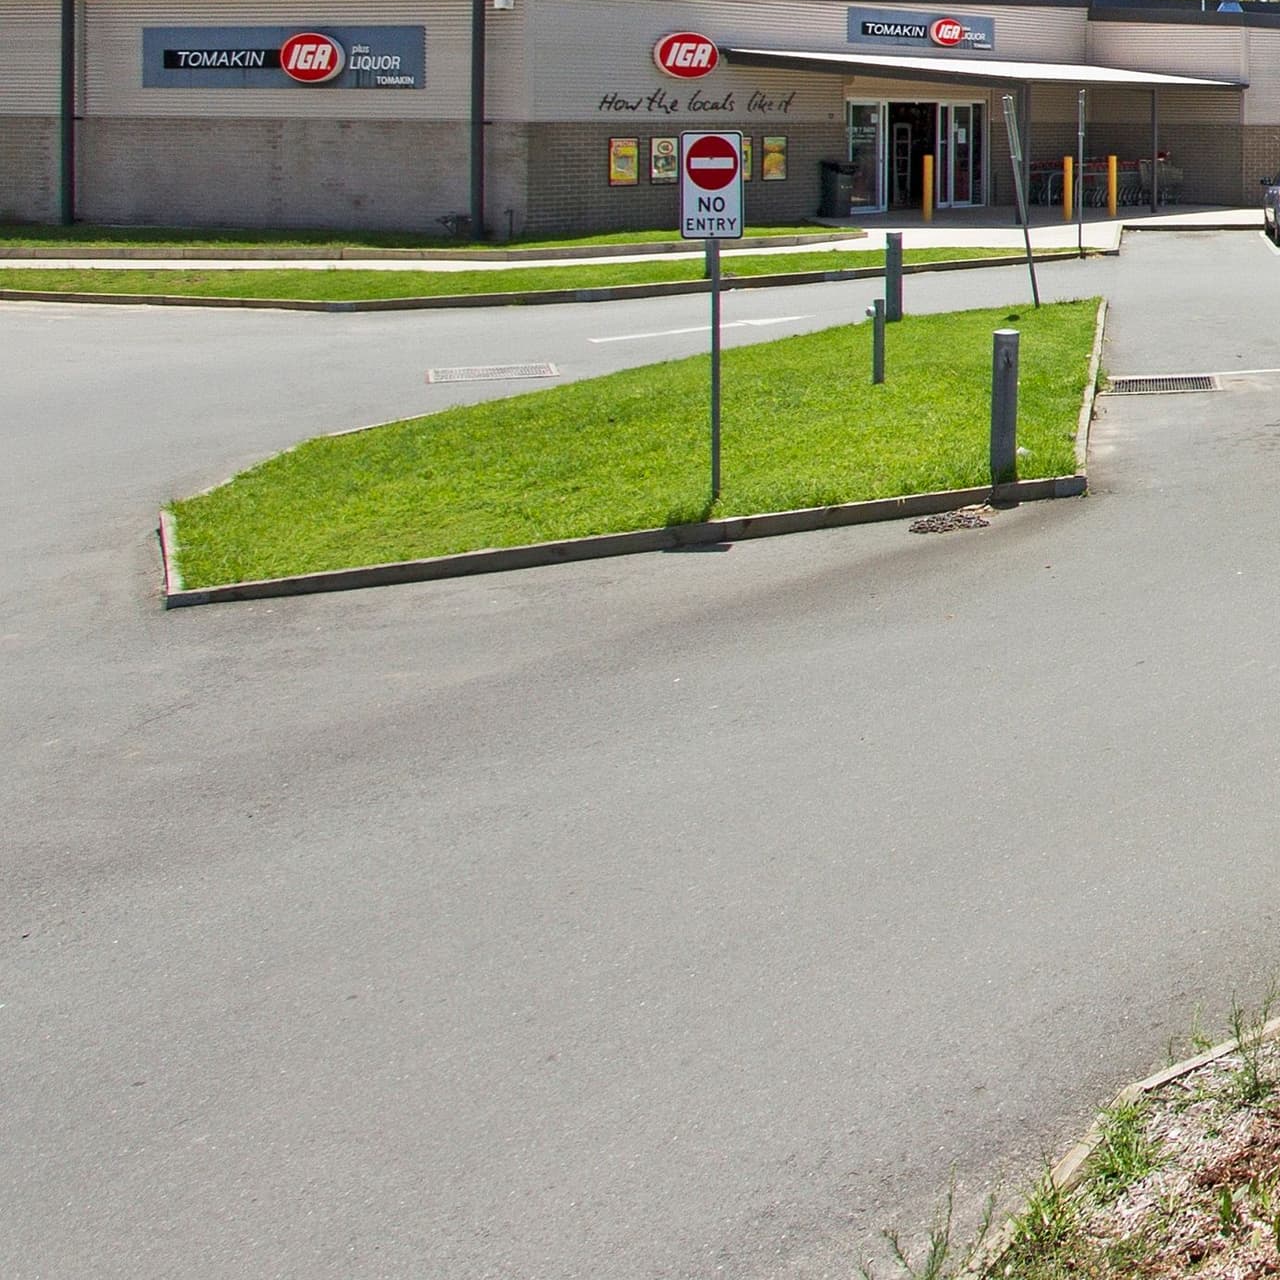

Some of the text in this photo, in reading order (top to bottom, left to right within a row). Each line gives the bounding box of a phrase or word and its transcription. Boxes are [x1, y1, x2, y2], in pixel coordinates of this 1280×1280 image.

[866, 23, 961, 39] TOMAKIN IGA
[177, 43, 332, 70] TOMAKIN IGA
[352, 44, 370, 55] plus
[665, 42, 713, 68] IGA
[349, 55, 401, 71] LIQUOR
[376, 75, 415, 85] TOMAKIN
[598, 87, 798, 114] How the locals like it
[698, 196, 725, 213] NO
[686, 217, 737, 231] ENTRY
